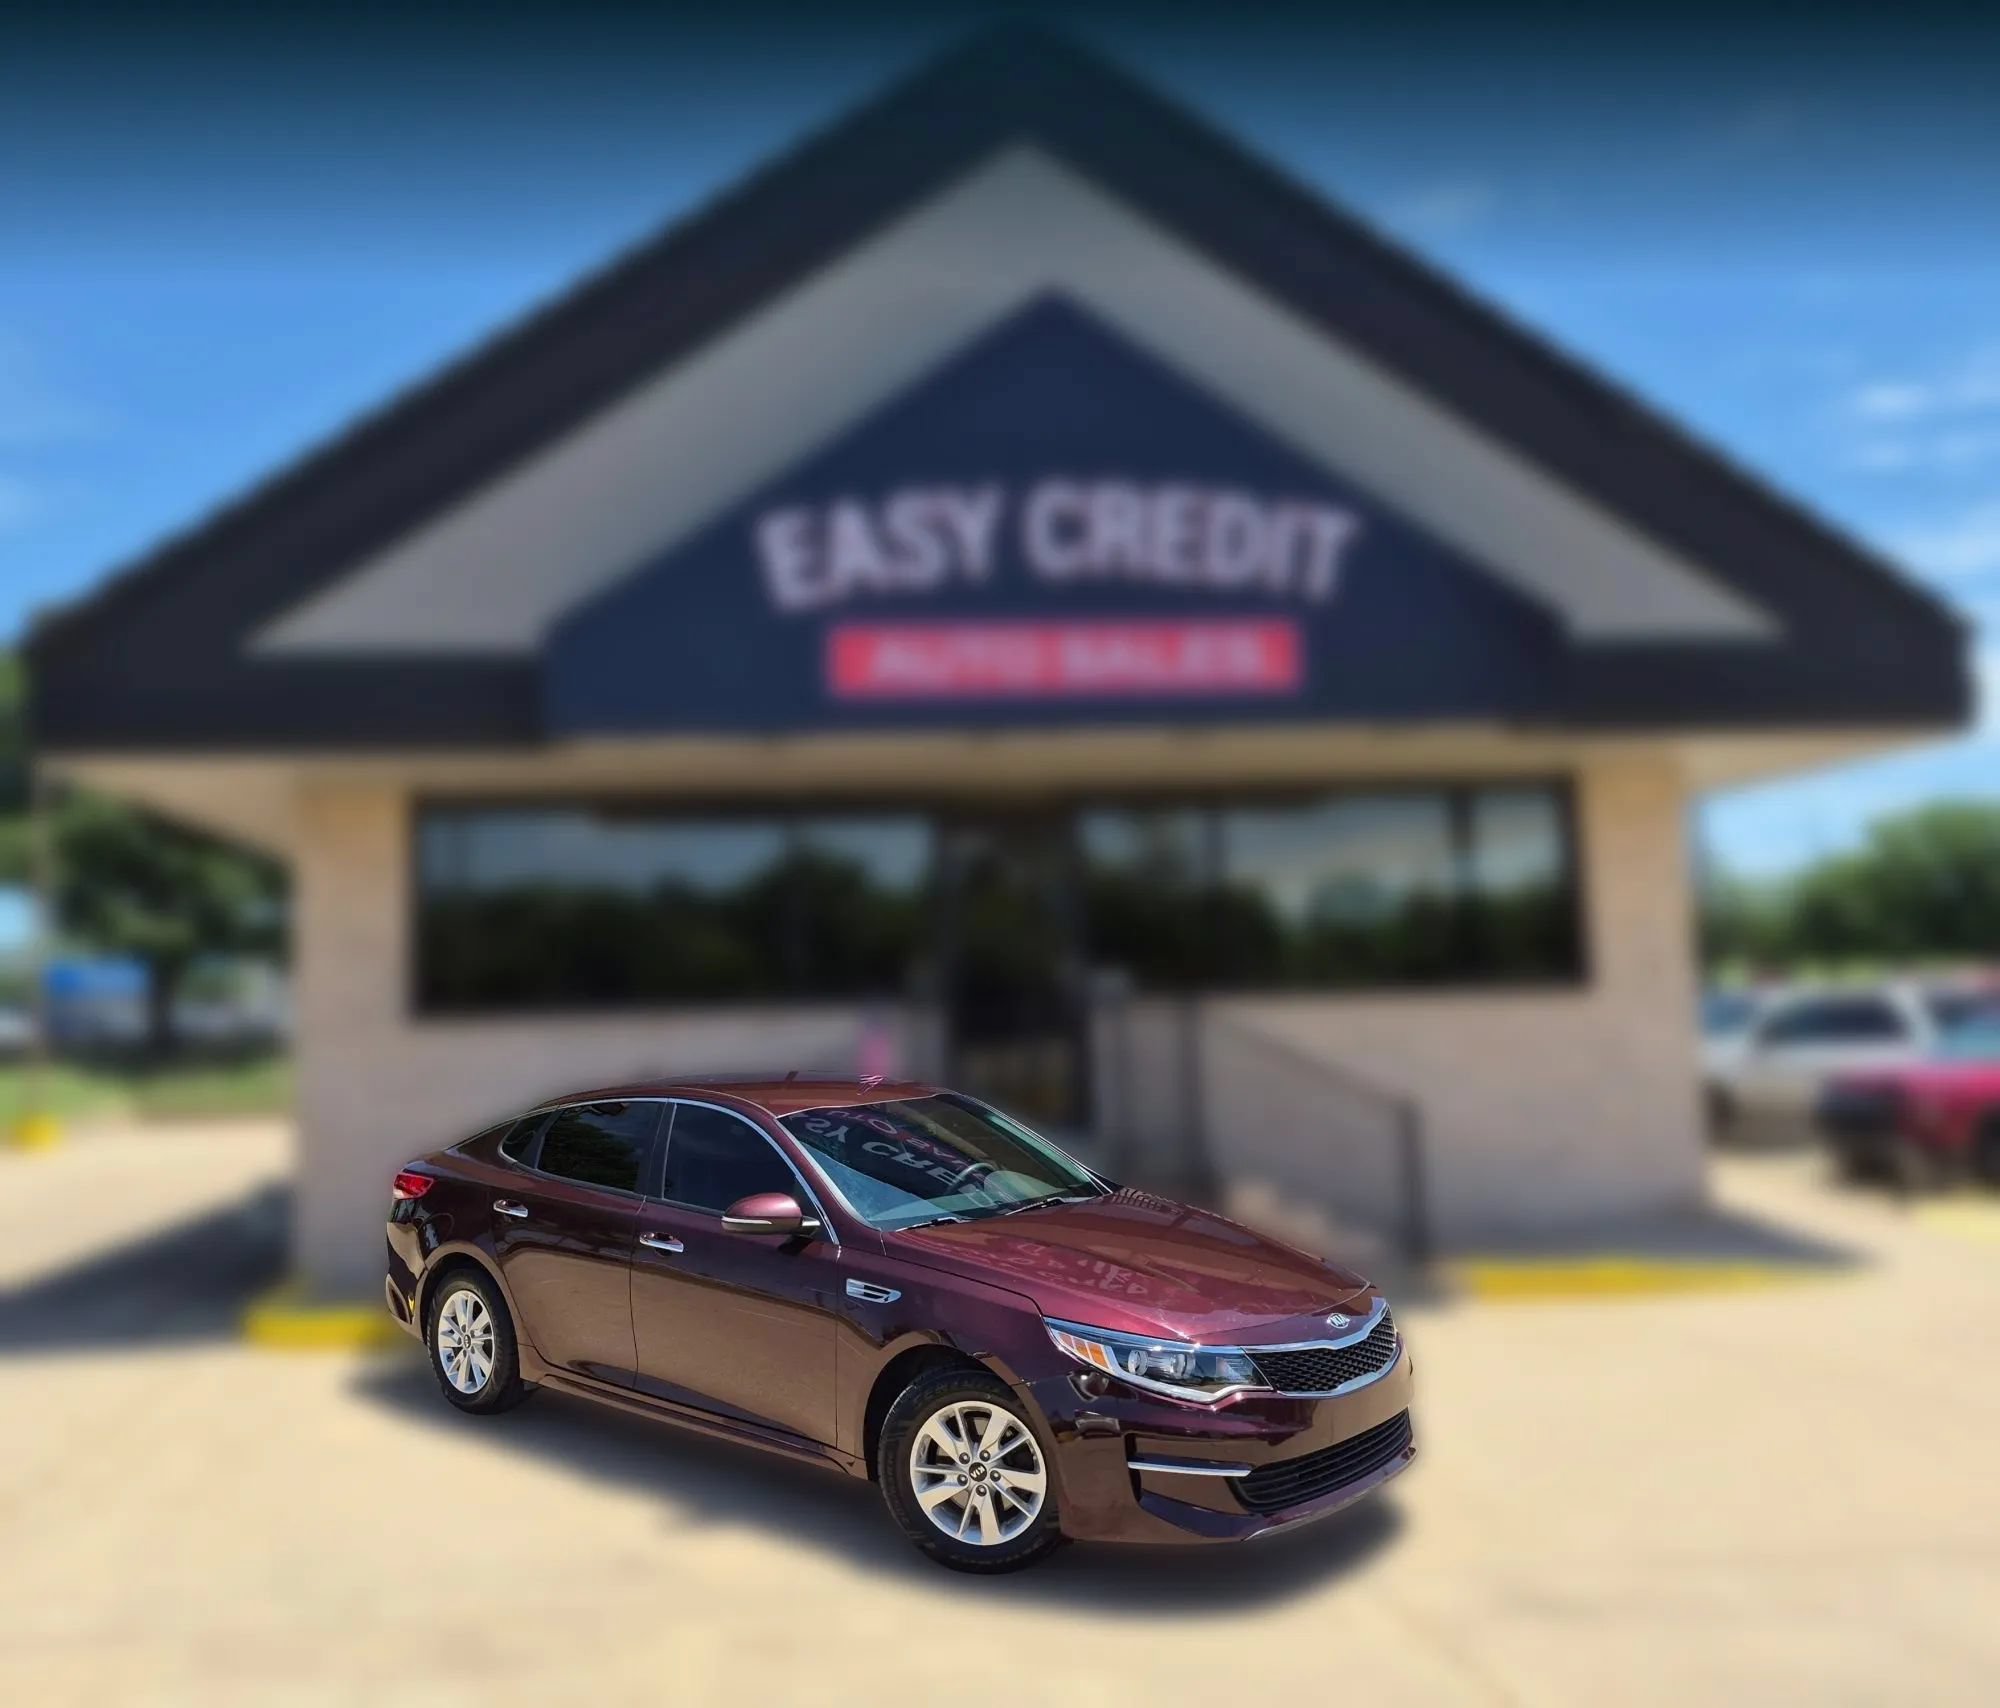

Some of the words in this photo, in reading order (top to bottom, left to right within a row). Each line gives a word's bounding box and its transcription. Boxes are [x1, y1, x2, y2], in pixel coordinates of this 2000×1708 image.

[758, 486, 998, 607] EASY
[1024, 478, 1360, 602] CREDIT
[869, 628, 1036, 687] AUTO
[1058, 624, 1268, 684] SALES
[970, 1465, 986, 1478] KIA
